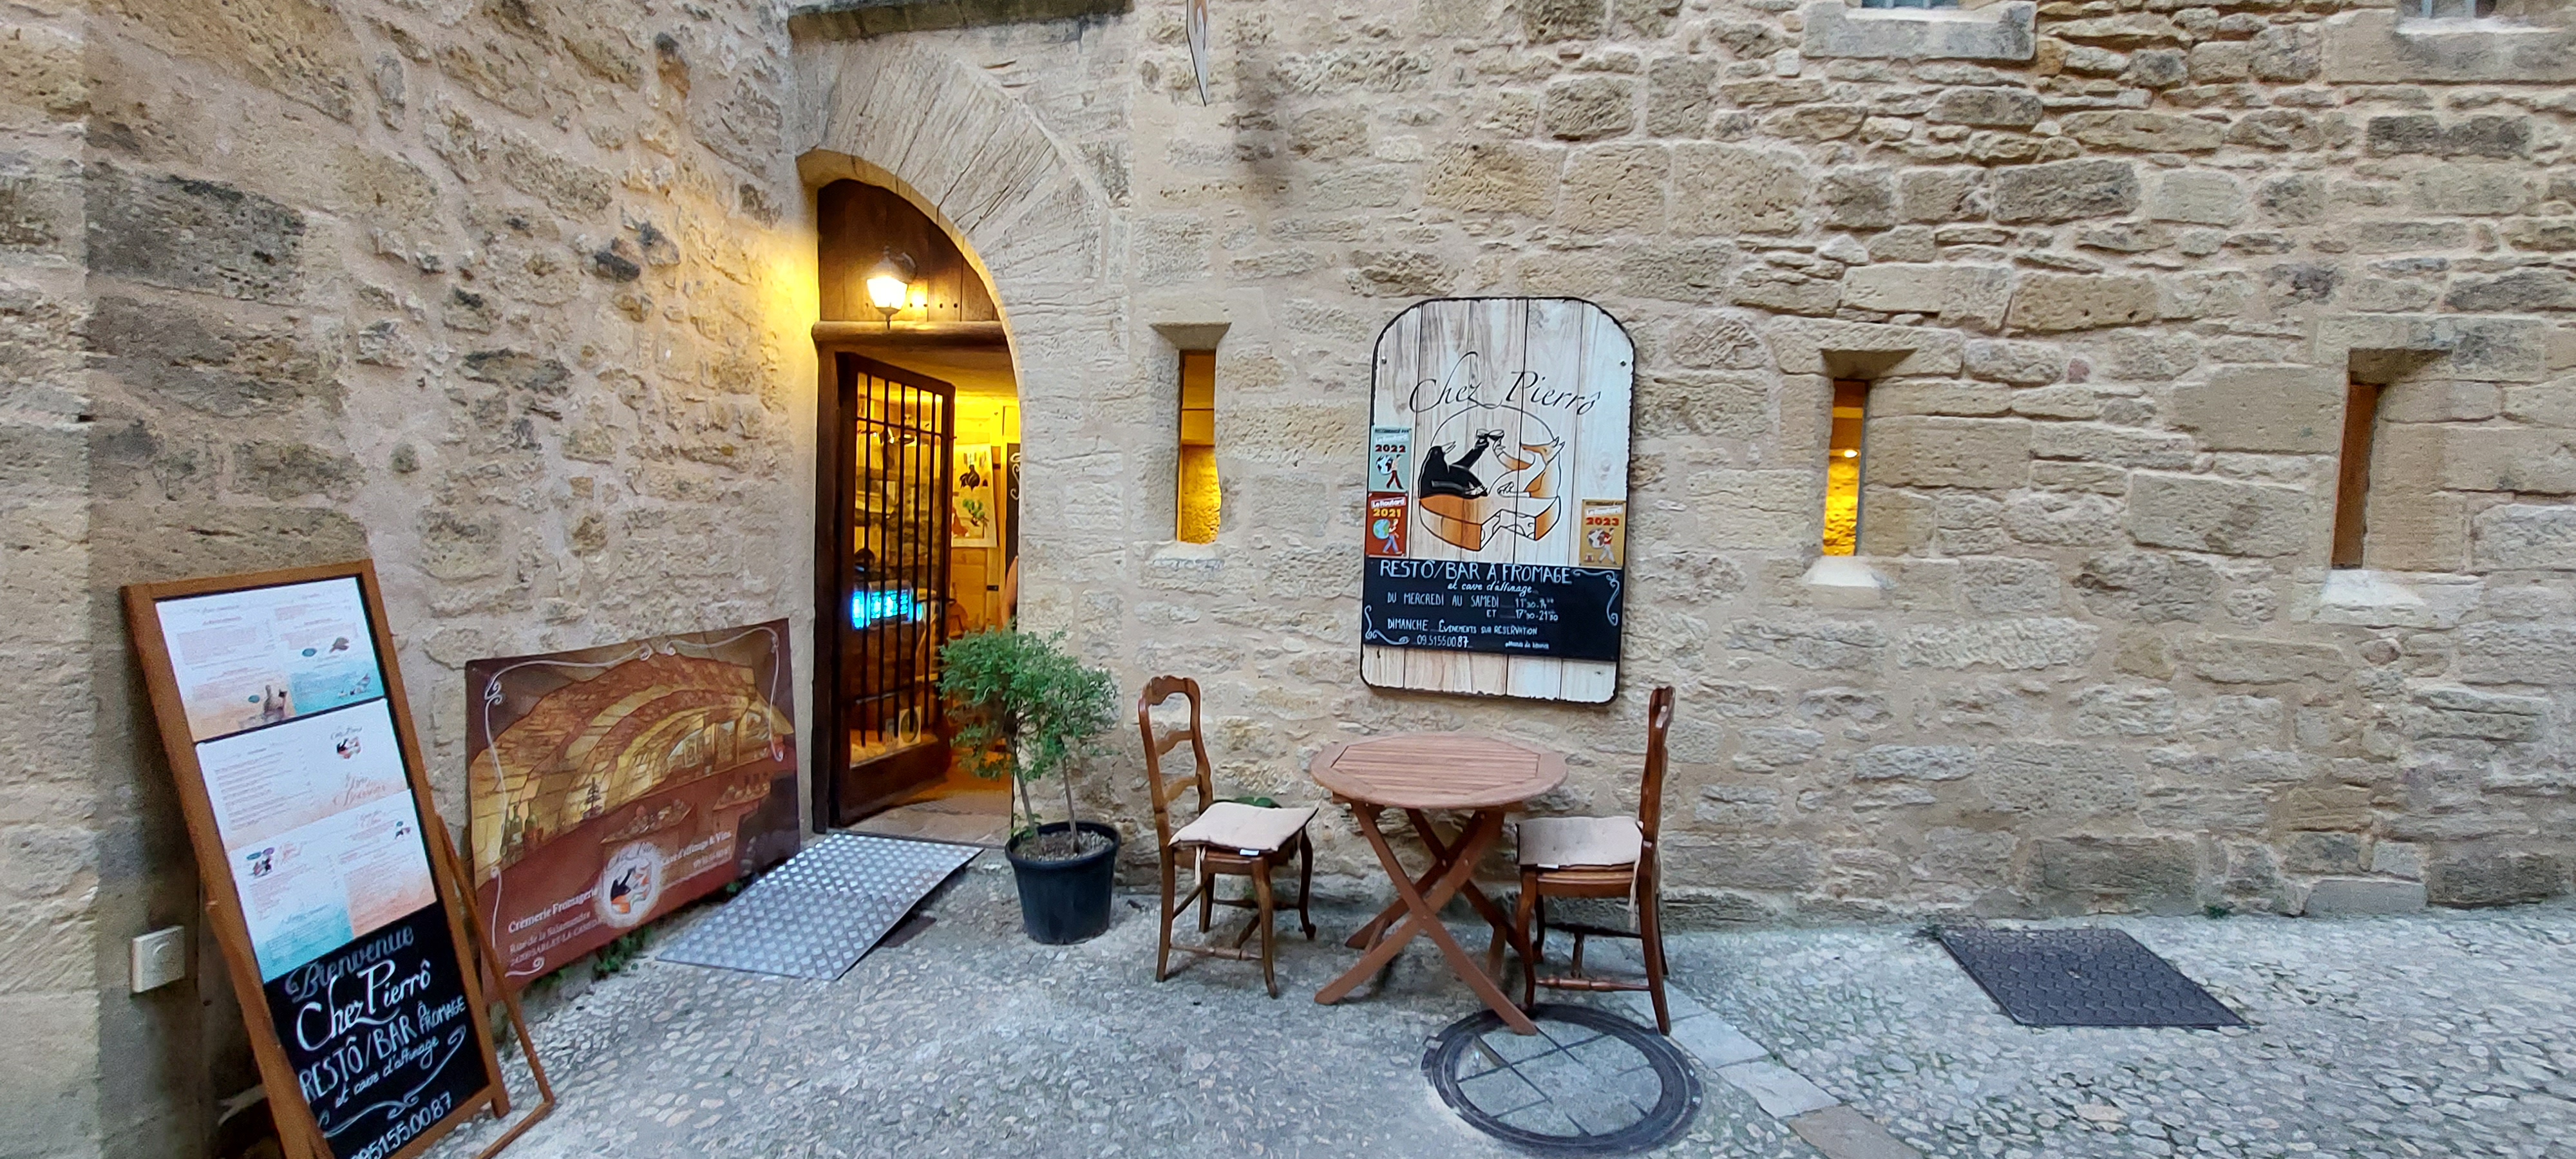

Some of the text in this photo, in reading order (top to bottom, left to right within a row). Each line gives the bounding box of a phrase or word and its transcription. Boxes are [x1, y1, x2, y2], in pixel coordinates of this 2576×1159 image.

[1410, 352, 1601, 415] Chez Pierrô
[1375, 444, 1406, 453] 2022
[1373, 508, 1401, 517] 2021
[1586, 517, 1619, 526] 2023
[1502, 564, 1573, 584] FROMAGE
[1387, 592, 1397, 603] DU
[1403, 592, 1444, 606] MERCREDI
[1452, 595, 1463, 607] AU
[1470, 594, 1499, 608] SAMEDI
[1387, 617, 1429, 631] DIMANCHE
[285, 925, 414, 1003] Bienvenue
[296, 958, 431, 1051] Chez Pierrô
[419, 995, 466, 1035] FROMAGE
[335, 1086, 350, 1108] et
